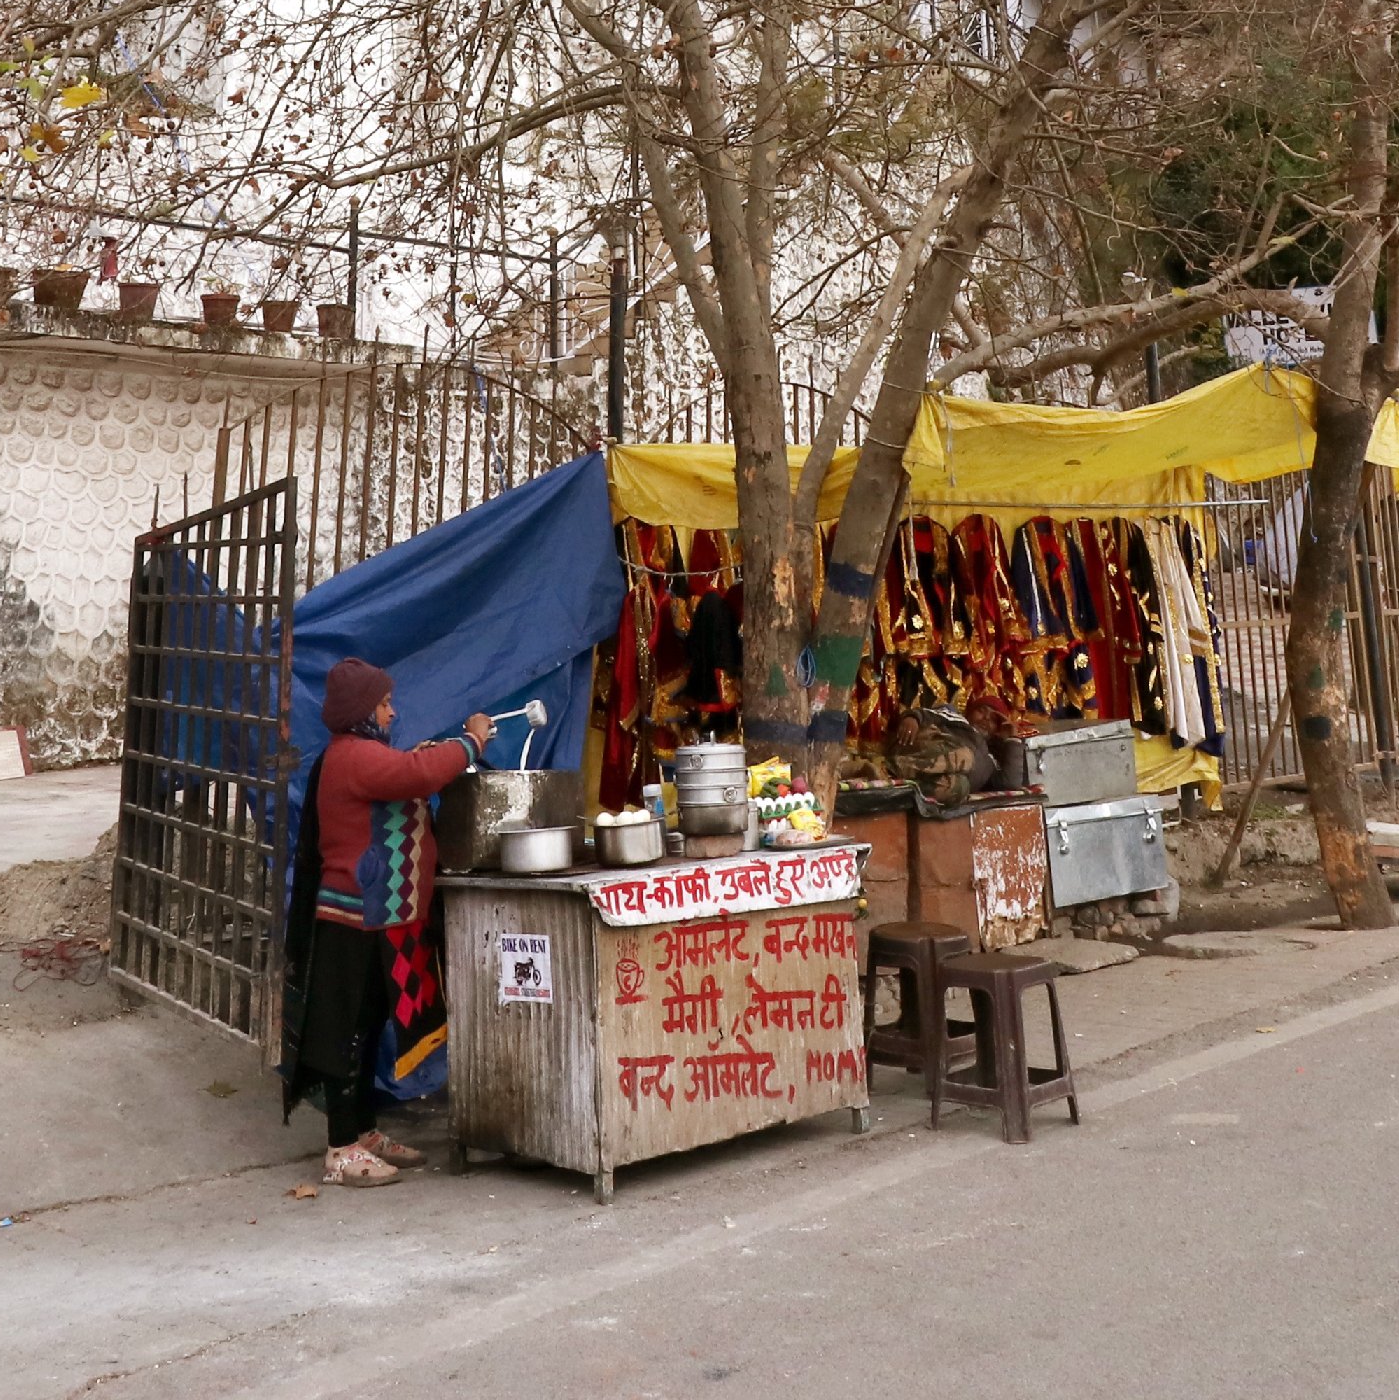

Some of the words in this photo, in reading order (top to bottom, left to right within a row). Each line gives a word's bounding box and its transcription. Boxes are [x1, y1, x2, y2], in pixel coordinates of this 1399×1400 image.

[502, 938, 517, 952] BIKE
[519, 938, 528, 952] ON
[529, 939, 546, 953] RENT
